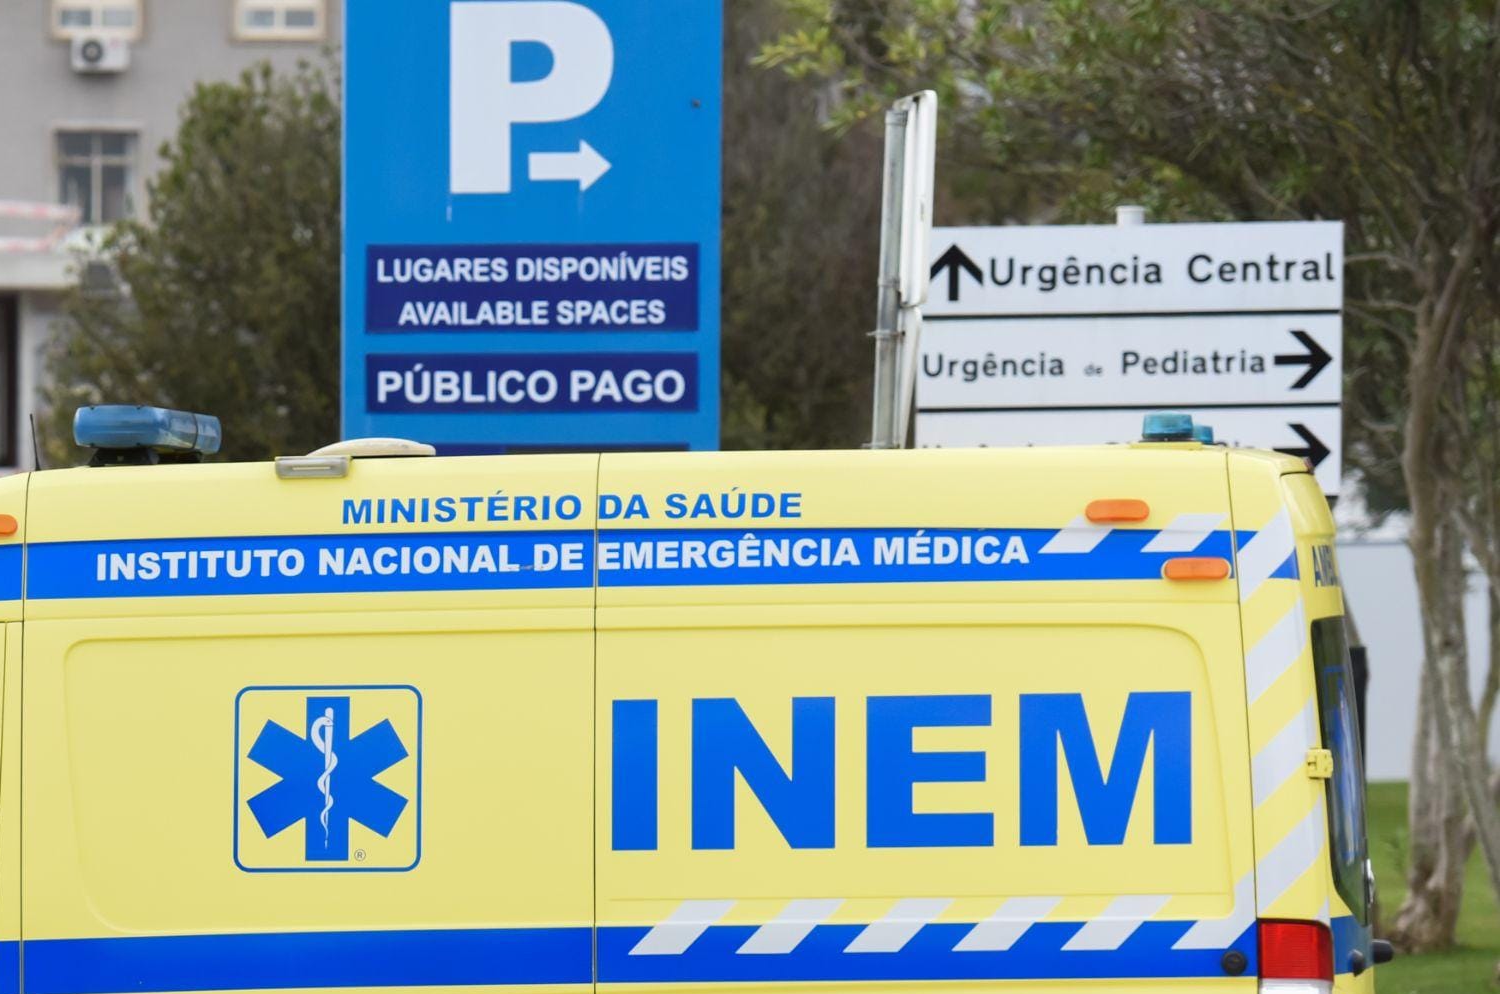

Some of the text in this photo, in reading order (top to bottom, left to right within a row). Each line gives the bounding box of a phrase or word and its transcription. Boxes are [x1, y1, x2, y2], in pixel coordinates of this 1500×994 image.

[449, 0, 615, 194] P
[376, 251, 689, 283] LUGARES DISPONÍVEIS
[989, 252, 1335, 293] Urgência Central
[398, 299, 666, 326] AVAILABLE SPACES
[377, 363, 686, 404] PÚBLICO PAGO
[922, 349, 1266, 383] Urgência de Pediatria
[342, 486, 802, 525] MINISTÉRIO DA SAÚDE
[96, 530, 1030, 582] INSTITUTO NACIONAL DE EMERGÊNCIA MÉDICA
[611, 690, 1193, 852] INEM
